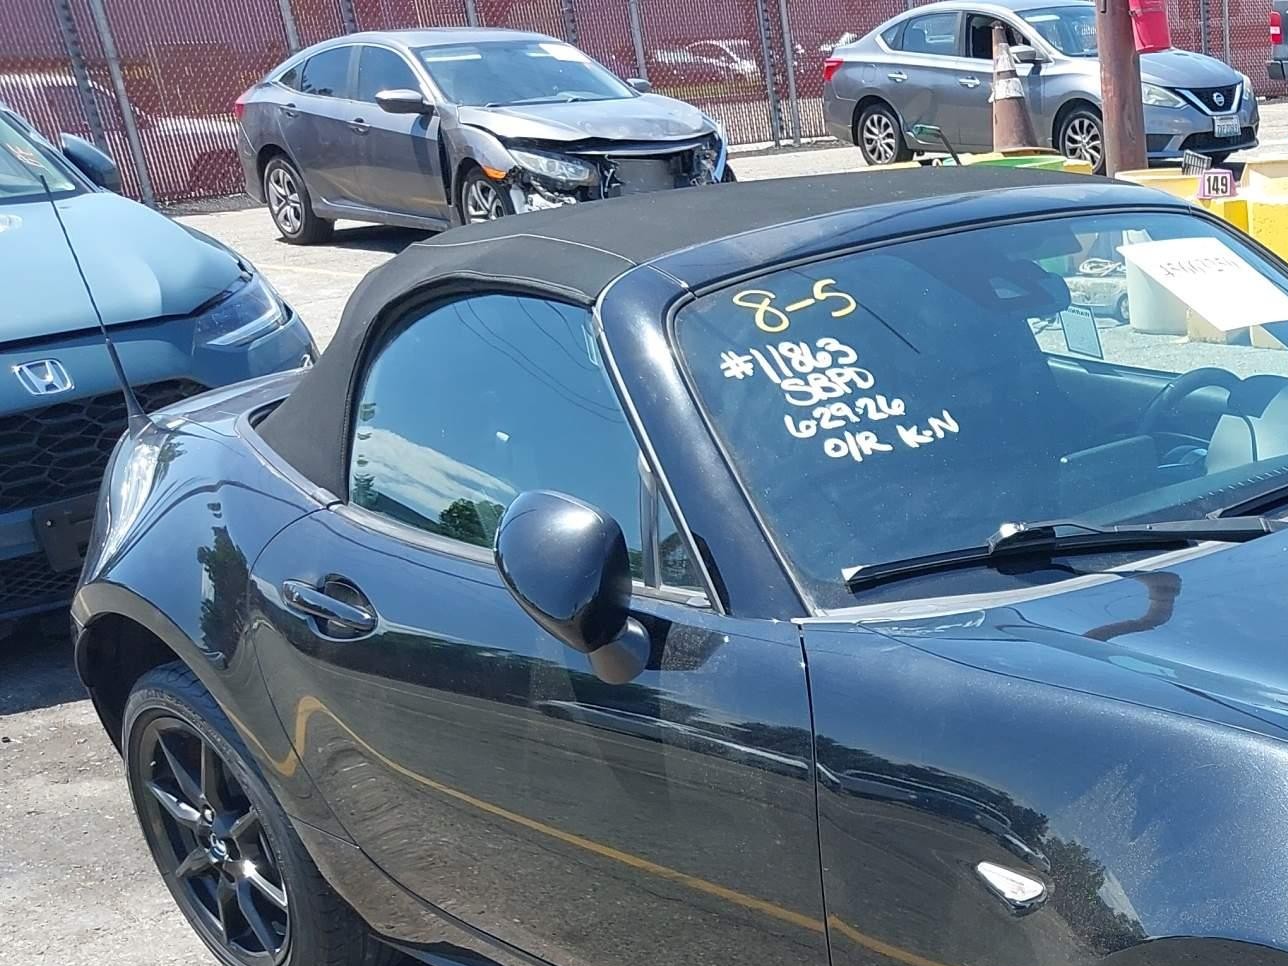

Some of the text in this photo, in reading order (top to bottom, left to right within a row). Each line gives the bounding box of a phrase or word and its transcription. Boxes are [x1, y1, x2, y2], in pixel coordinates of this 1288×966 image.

[1206, 175, 1228, 195] 149
[732, 278, 857, 332] 8-5
[720, 337, 858, 384] #11863
[780, 366, 875, 406] SBPD
